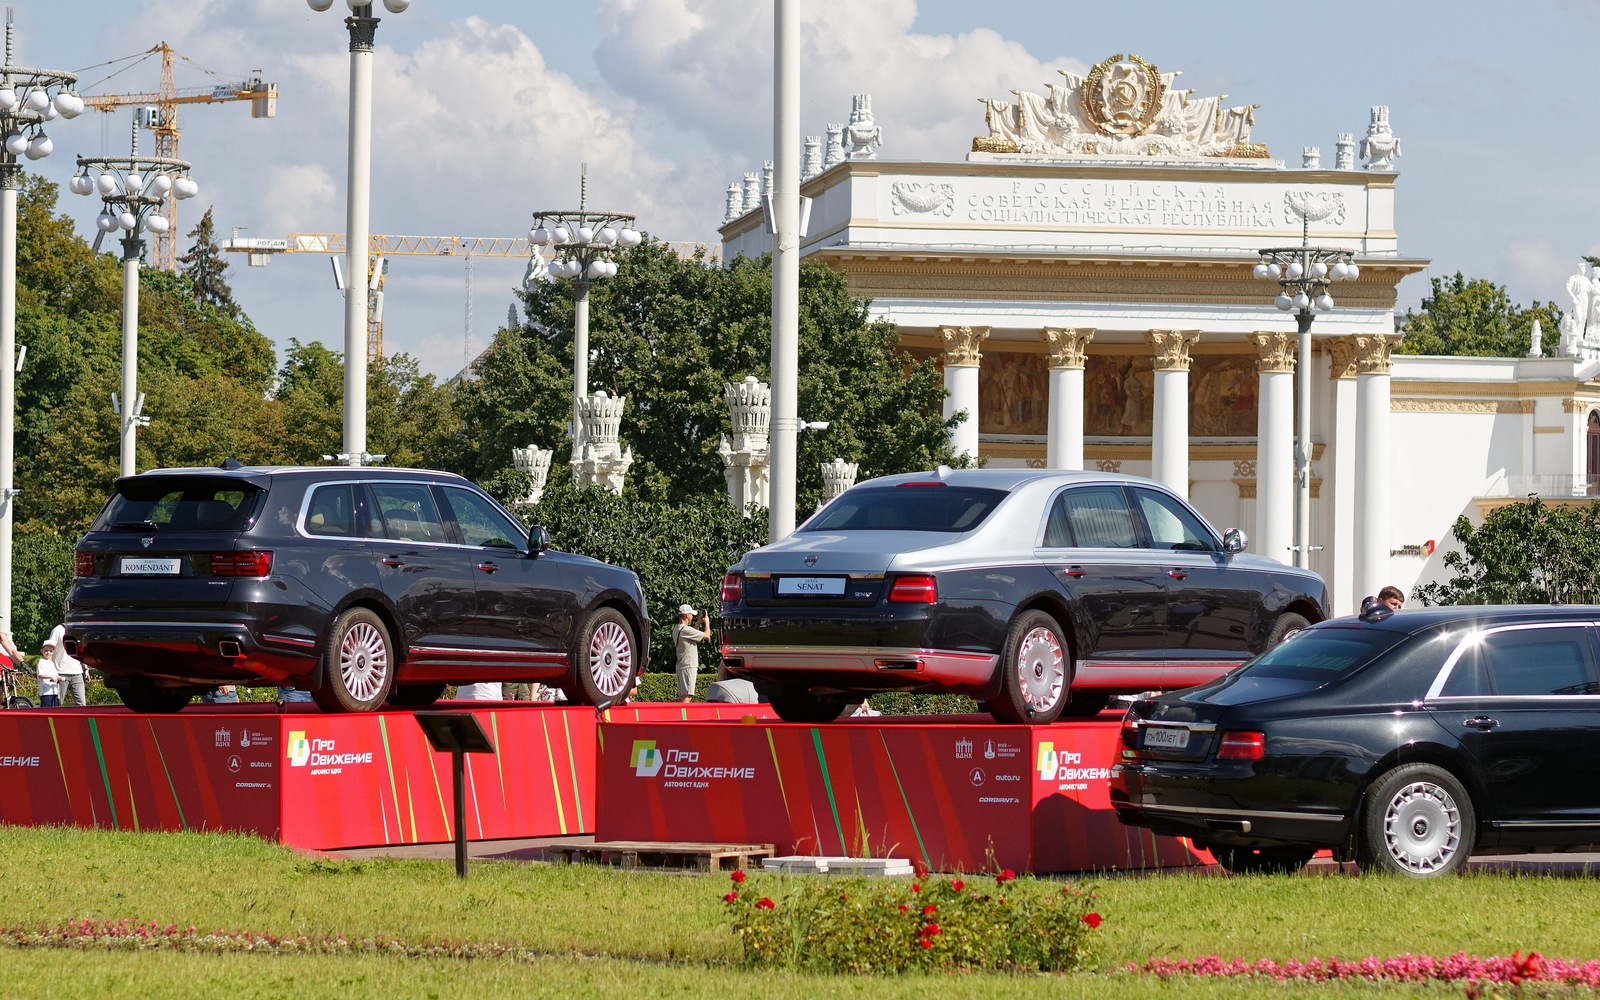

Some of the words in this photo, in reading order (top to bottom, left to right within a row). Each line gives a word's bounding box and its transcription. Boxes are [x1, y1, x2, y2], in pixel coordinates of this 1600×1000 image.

[1012, 181, 1225, 199] РОССИЙСКАЯ
[968, 195, 1092, 209] СОВЕТСКАЯ
[1103, 197, 1273, 213] ФЕДЕРАТИВНАЯ
[968, 209, 1152, 225] СОЦИАЛИСТИЧЕСКАЯ
[1162, 213, 1276, 228] РЕСПУБЛИКА
[125, 564, 175, 572] KOMENDANT
[796, 583, 825, 591] SENAT
[1058, 766, 1111, 780] DВИЖЕНИ
[693, 781, 710, 789] ВДНХ
